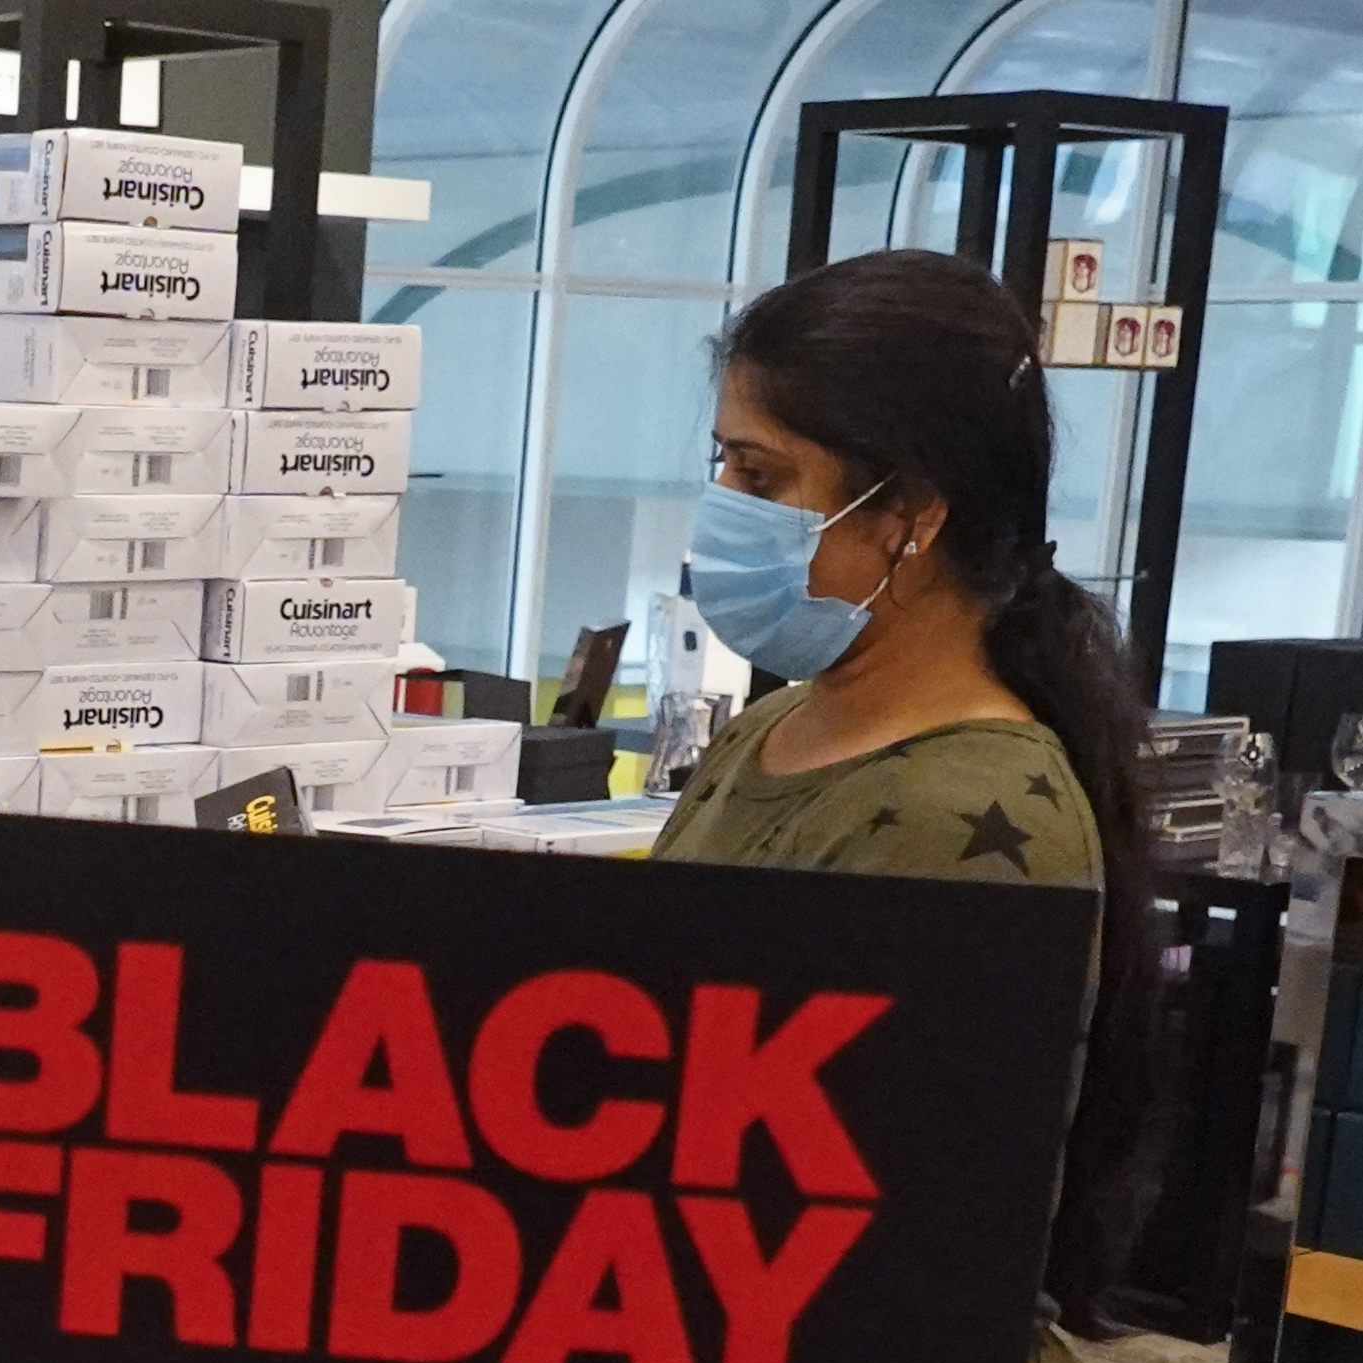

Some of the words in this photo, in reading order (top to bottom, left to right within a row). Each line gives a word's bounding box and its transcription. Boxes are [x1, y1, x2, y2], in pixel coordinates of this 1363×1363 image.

[42, 139, 55, 217] Cuisinart
[117, 160, 193, 184] Advantage
[103, 178, 205, 210] Cuisinart
[40, 230, 54, 307] Cuisinart
[116, 252, 189, 275] Advantage
[100, 271, 201, 301] Cuisinart
[245, 330, 258, 404] Cuisinart
[314, 349, 380, 367] Advantage
[300, 368, 391, 392] Cuisinart
[295, 434, 364, 453] Advantage
[280, 453, 375, 477] Cuisinart
[279, 597, 373, 621] Cuisinart
[223, 588, 236, 658] Cuisinart
[290, 622, 359, 641] Advantage
[79, 687, 152, 705] Advantage
[63, 705, 165, 730] Cuisinart
